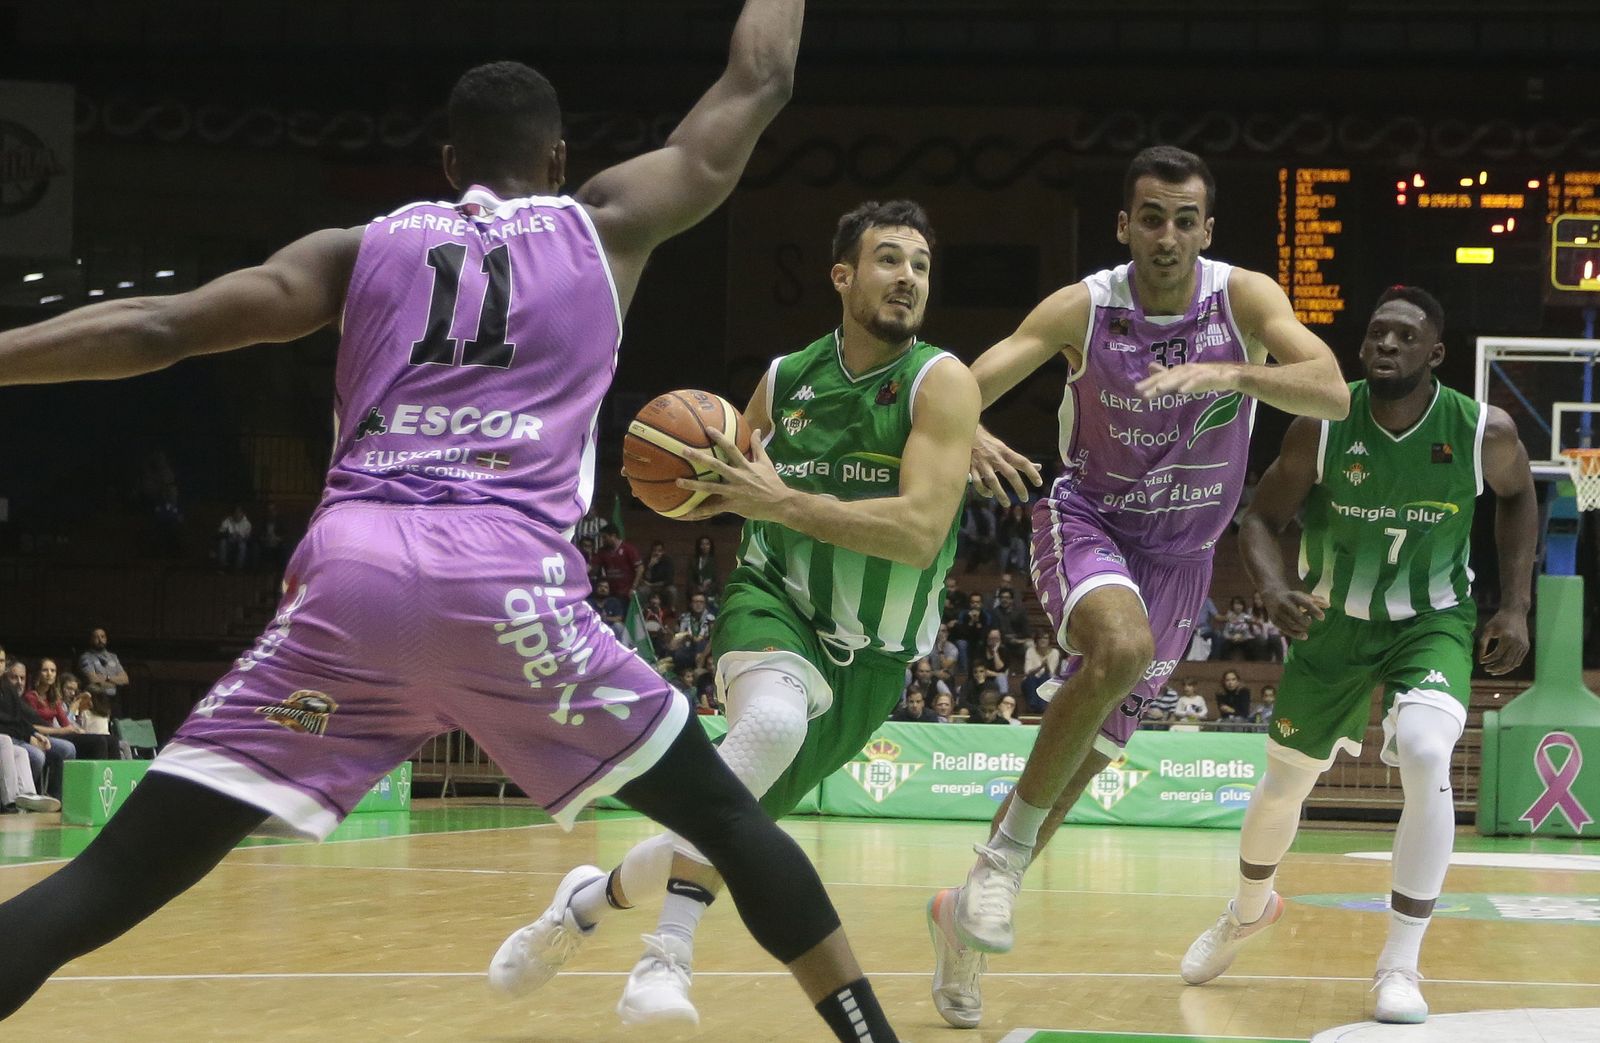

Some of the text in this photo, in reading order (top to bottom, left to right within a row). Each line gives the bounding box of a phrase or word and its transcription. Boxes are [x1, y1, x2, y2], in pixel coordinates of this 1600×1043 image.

[408, 241, 516, 369] 11
[389, 404, 544, 441] ESCOR
[1109, 423, 1180, 446] tdfood
[363, 447, 470, 467] EUSKADI
[842, 462, 891, 484] plus
[1144, 474, 1173, 487] visit
[1170, 482, 1223, 501] álava
[1332, 501, 1396, 521] nergía
[1384, 527, 1408, 565] 7
[932, 751, 1026, 771] RealBetis
[1160, 759, 1255, 778] RealBetis
[931, 782, 1015, 796] energía plu
[1160, 788, 1252, 804] energía plus
